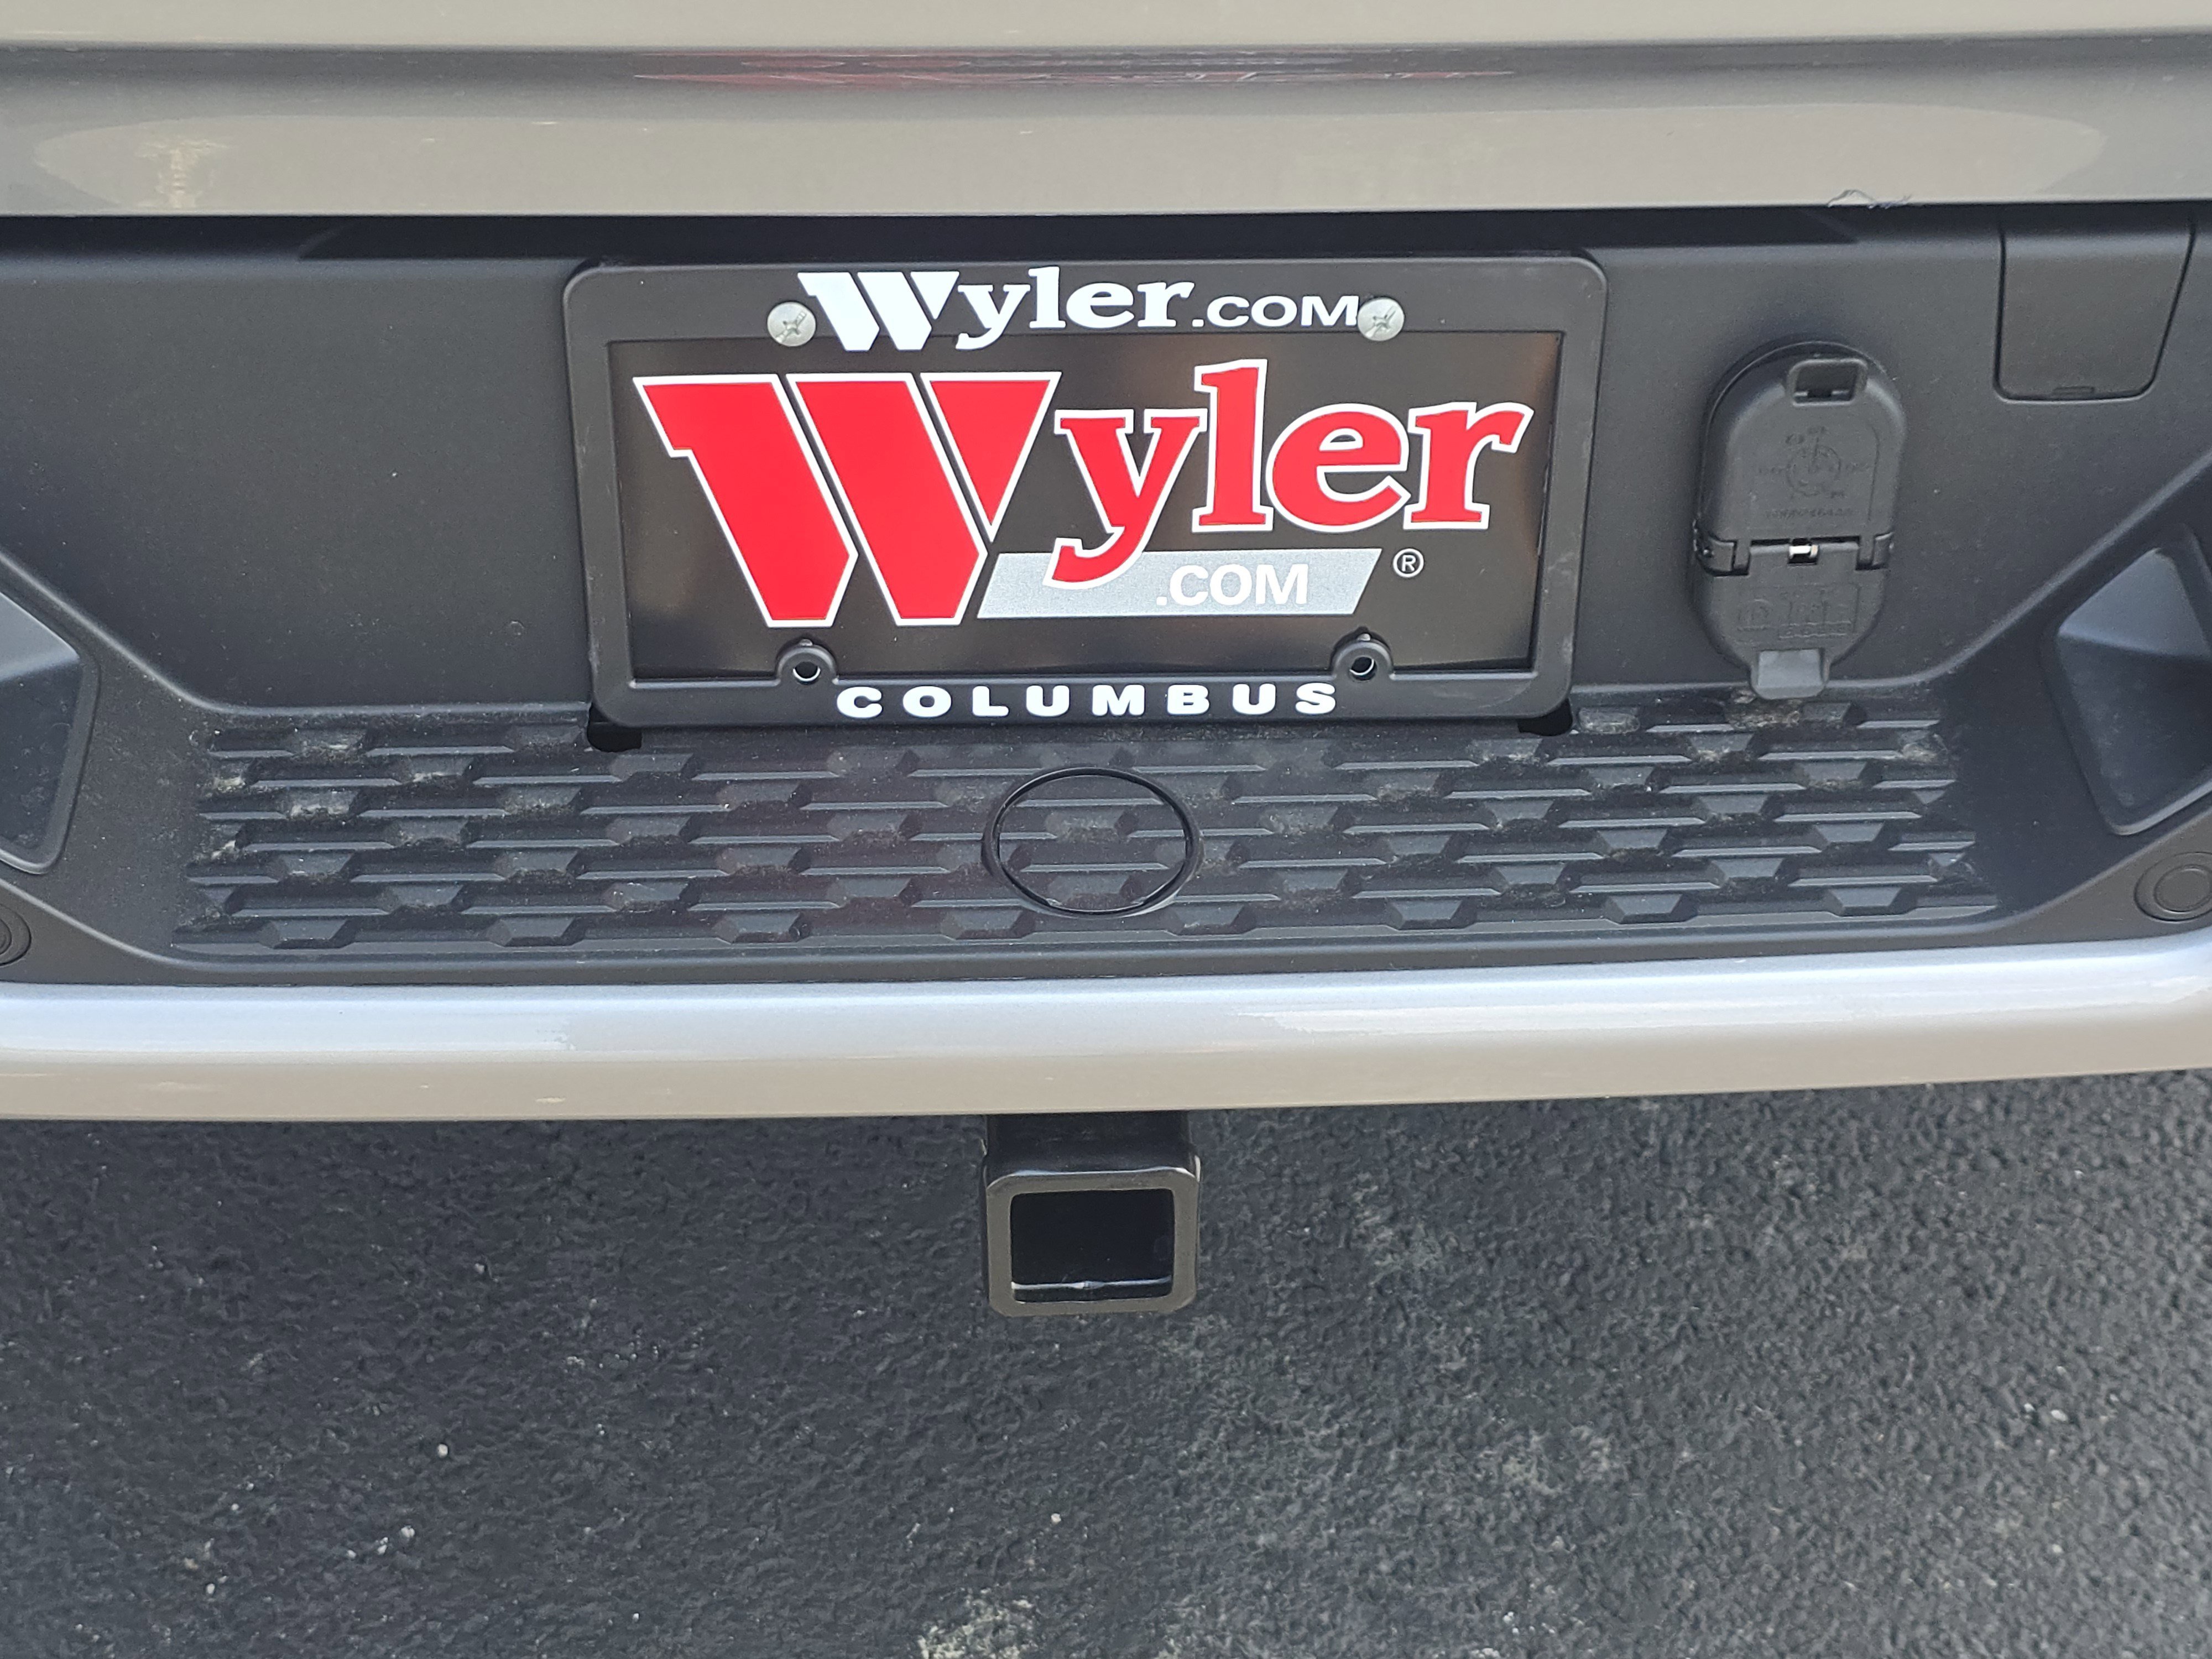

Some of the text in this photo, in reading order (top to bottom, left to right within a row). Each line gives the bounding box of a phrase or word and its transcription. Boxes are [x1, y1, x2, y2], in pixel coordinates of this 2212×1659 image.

[633, 358, 1535, 628] Wyler
[1156, 564, 1310, 607] .COM
[836, 683, 1336, 718] COLUMBUS
